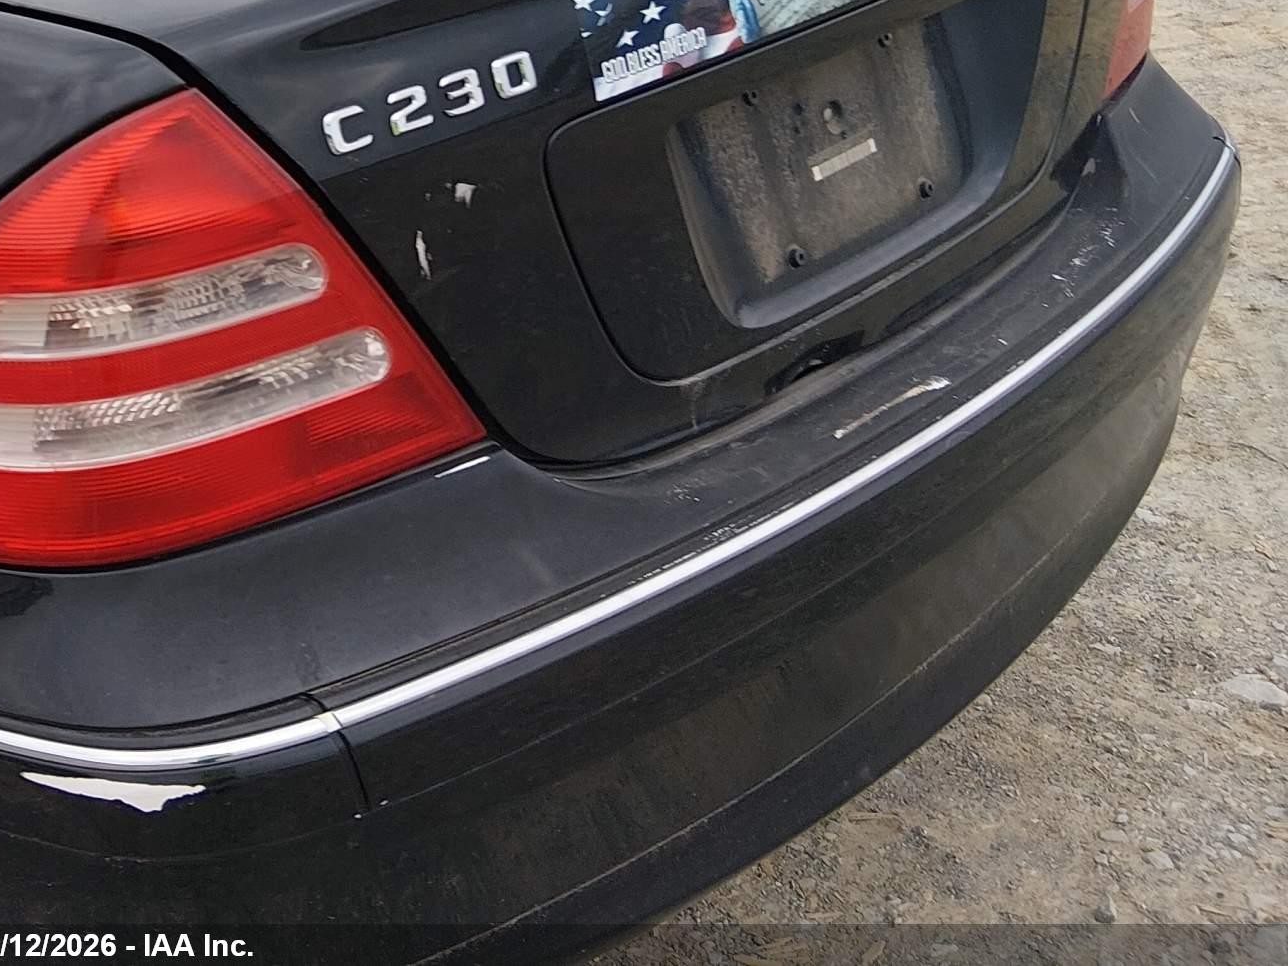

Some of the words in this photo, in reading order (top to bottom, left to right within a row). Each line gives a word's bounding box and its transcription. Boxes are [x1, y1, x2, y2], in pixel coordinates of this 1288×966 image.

[600, 56, 628, 83] GOD
[625, 43, 663, 76] BLESS
[659, 26, 708, 62] AMERICA
[322, 105, 374, 156] C
[386, 50, 538, 136] 230
